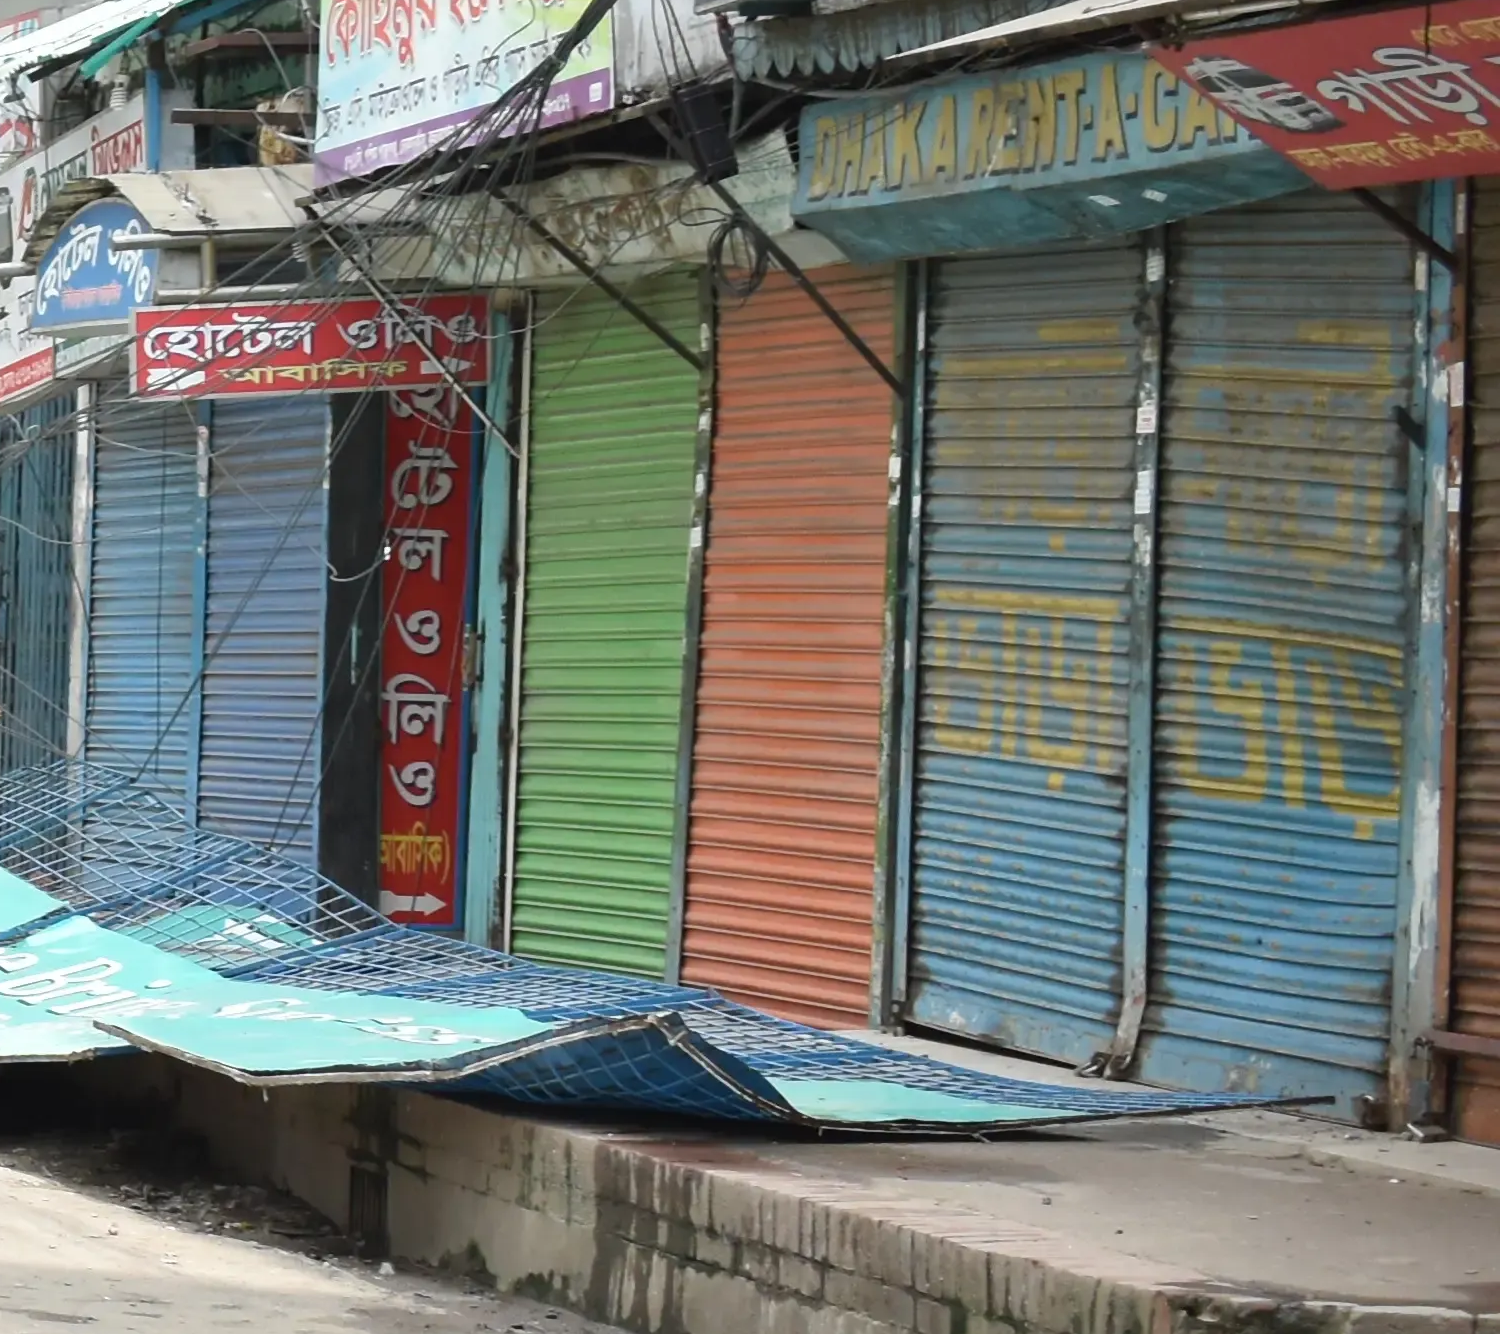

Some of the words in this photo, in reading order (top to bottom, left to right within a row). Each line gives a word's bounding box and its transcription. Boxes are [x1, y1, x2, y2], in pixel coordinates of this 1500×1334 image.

[807, 94, 960, 203] DHAKA
[37, 222, 102, 316] হোটেল
[143, 312, 316, 364] হোটেল
[214, 357, 409, 386] আবাসিক
